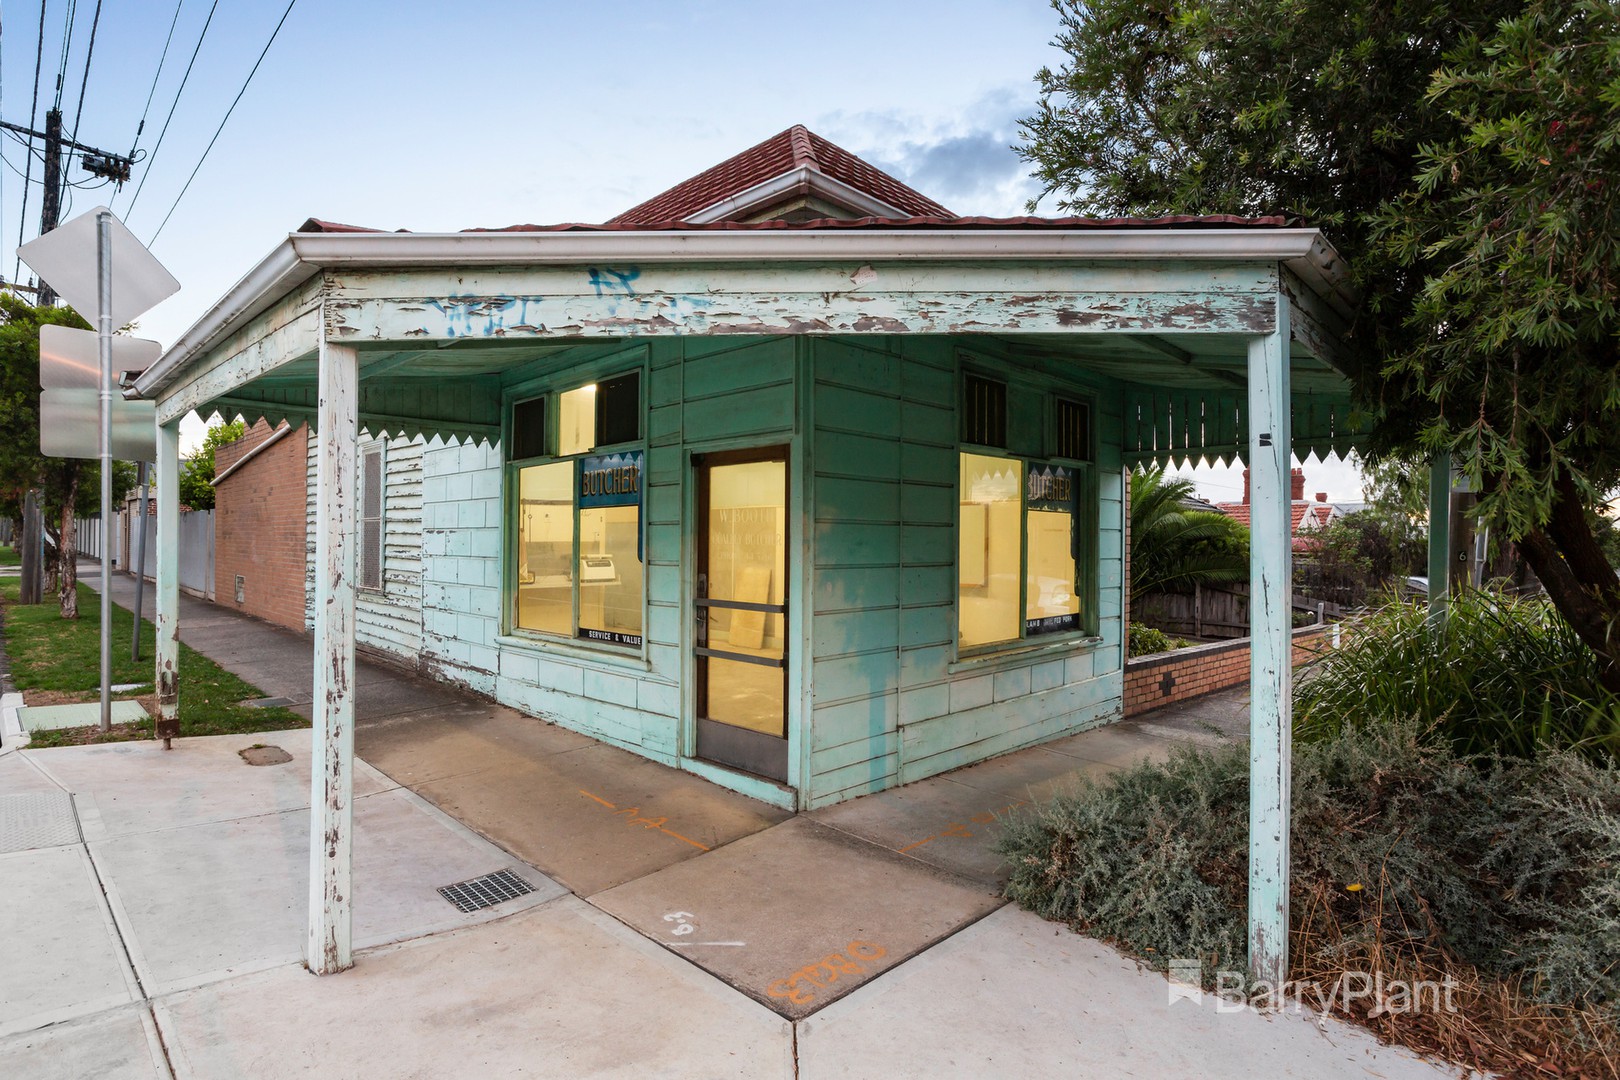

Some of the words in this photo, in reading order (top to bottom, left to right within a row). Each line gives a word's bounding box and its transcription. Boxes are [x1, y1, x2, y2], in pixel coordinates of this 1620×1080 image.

[582, 465, 638, 496] BUTCHER
[1027, 473, 1072, 501] BUTCHER
[1459, 551, 1467, 561] 6
[588, 630, 611, 641] SERVICE
[614, 634, 620, 642] &
[622, 635, 642, 645] VALUE
